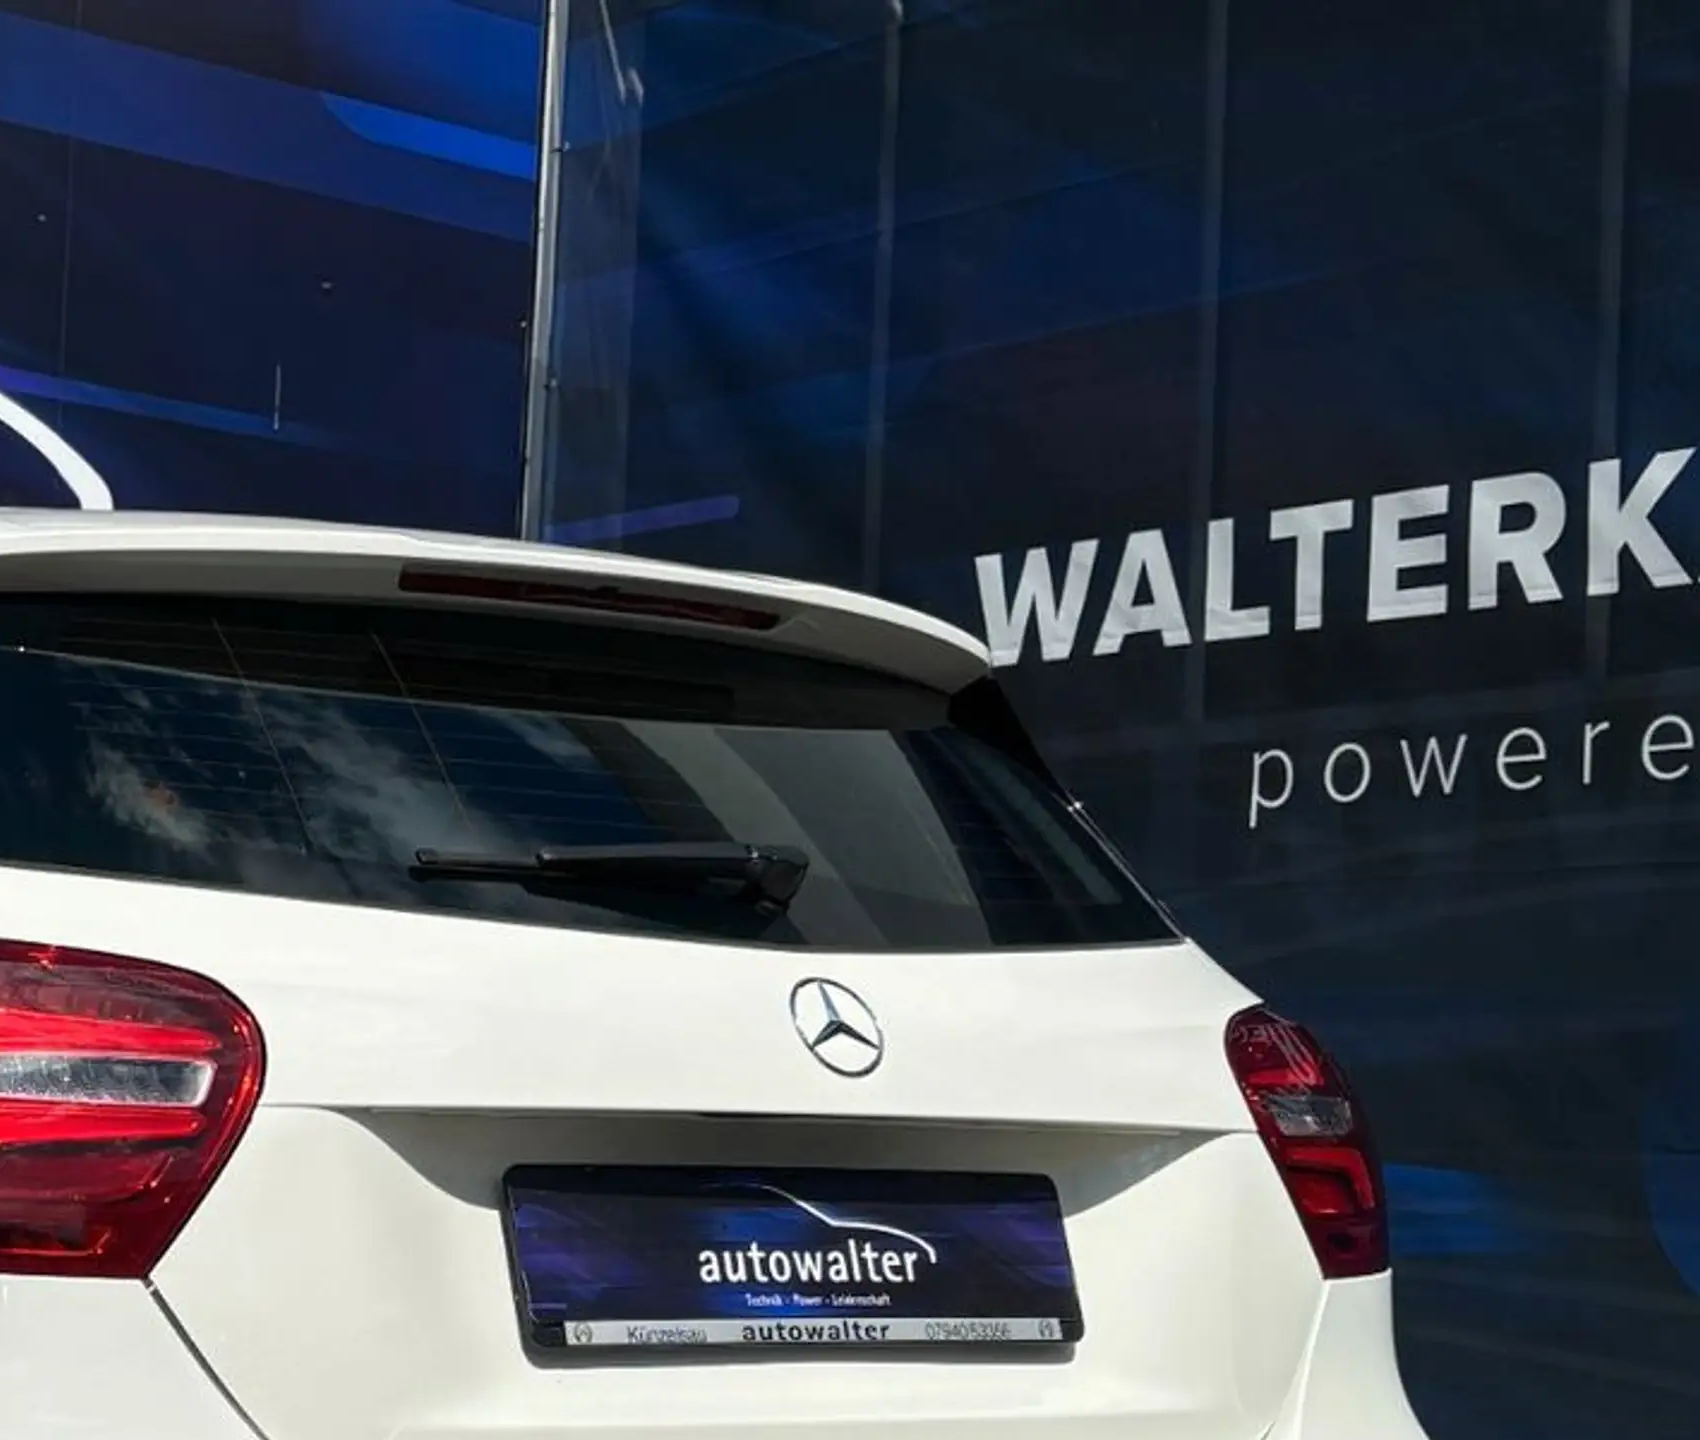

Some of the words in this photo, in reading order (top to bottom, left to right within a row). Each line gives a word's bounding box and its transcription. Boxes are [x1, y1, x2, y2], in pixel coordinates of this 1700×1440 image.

[974, 447, 1700, 667] WALTERK
[1249, 714, 1695, 829] powere
[699, 1238, 919, 1284] autowalter
[741, 1320, 890, 1342] autowalter
